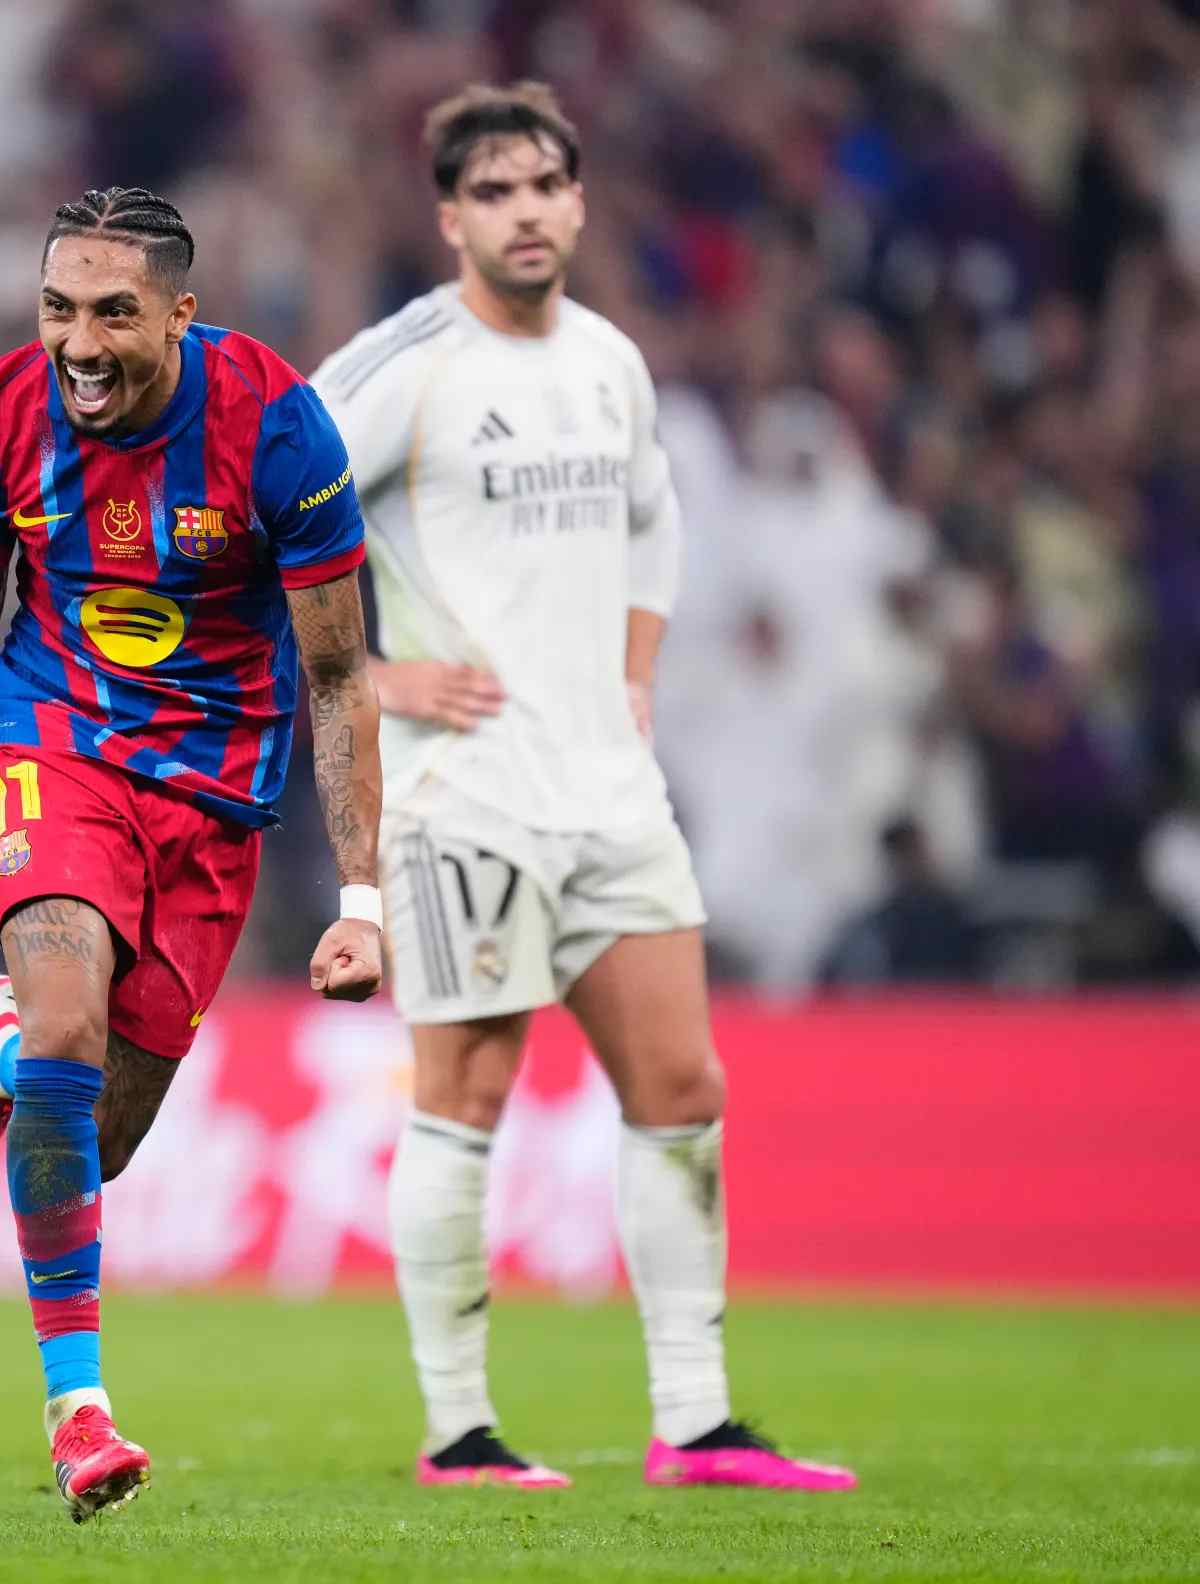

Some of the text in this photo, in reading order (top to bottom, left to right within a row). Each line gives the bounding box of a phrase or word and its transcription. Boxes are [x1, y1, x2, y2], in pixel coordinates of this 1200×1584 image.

[482, 454, 632, 500] Emirate
[99, 543, 146, 551] SUPERCOPA
[441, 849, 521, 930] 17
